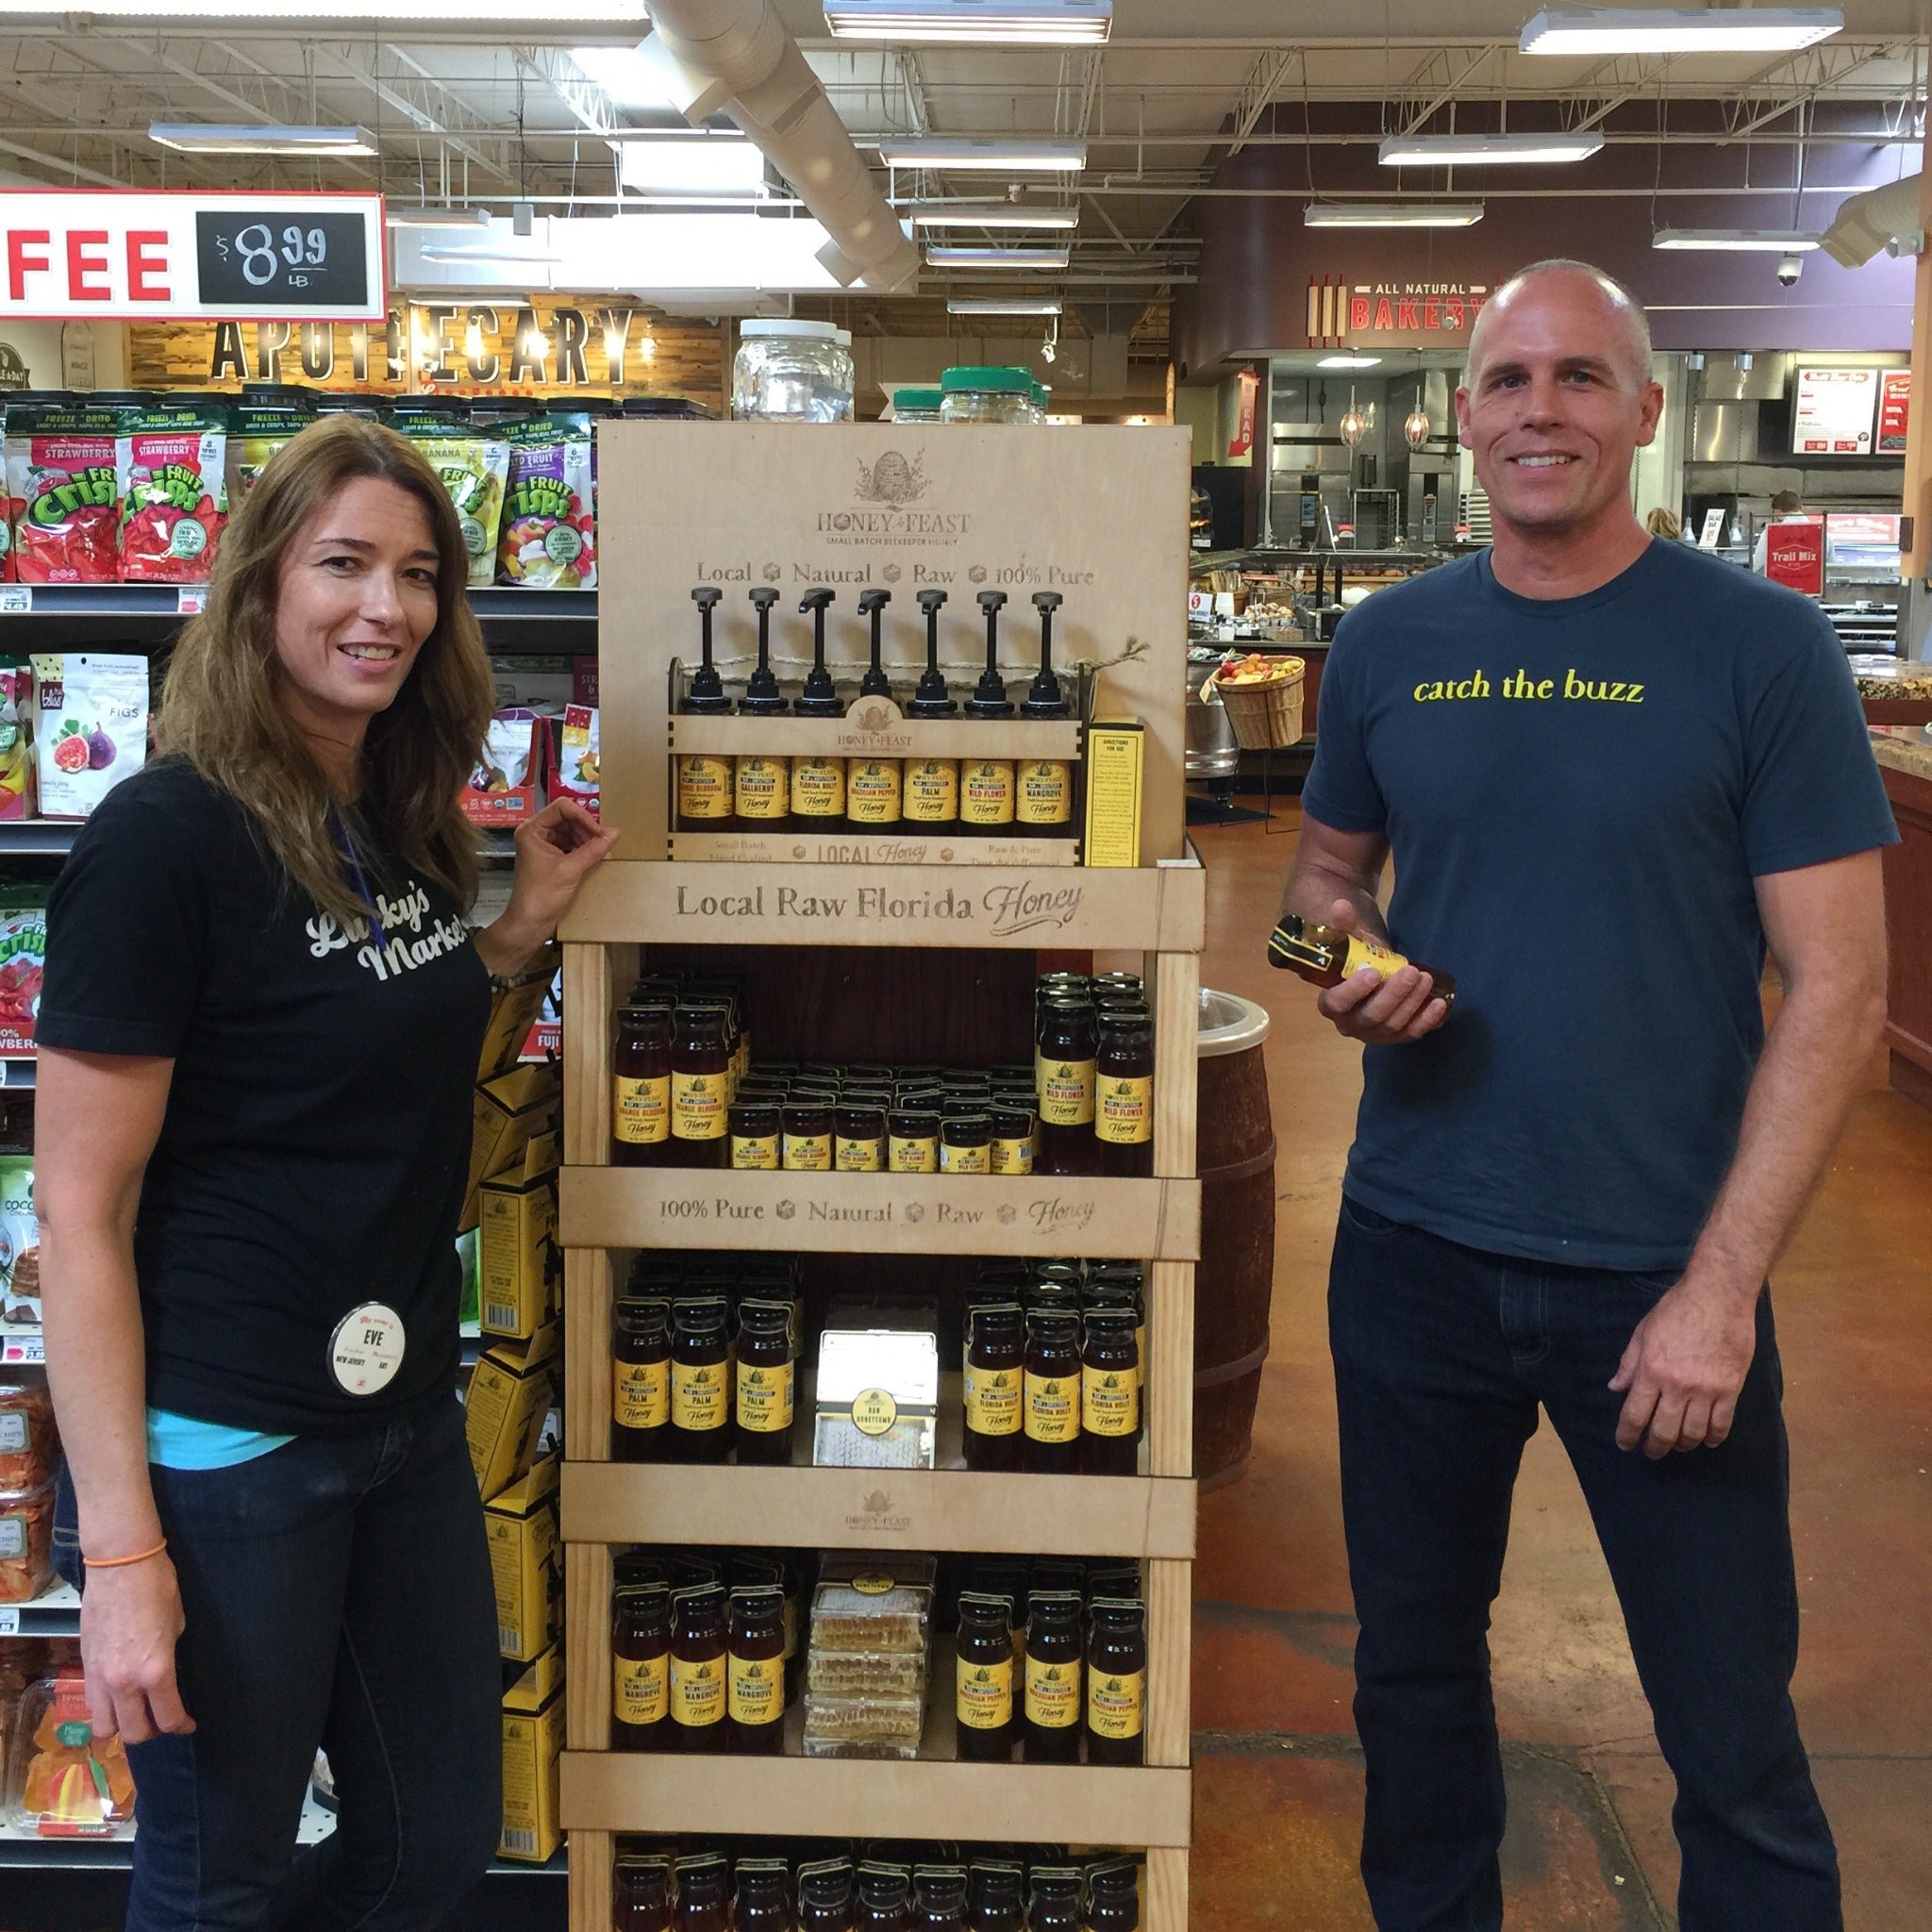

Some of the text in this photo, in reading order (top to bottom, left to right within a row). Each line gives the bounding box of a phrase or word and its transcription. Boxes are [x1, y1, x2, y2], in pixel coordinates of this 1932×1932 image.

[7, 229, 172, 302] FEE
[1375, 284, 1466, 295] ALL NATURAL
[528, 422, 553, 432] DRIED
[45, 447, 116, 458] STRAWBERRY
[139, 445, 190, 457] STRAWBERRY
[527, 453, 555, 469] FRUIT
[166, 465, 205, 490] FRUIT
[529, 475, 574, 497] FRUIT
[817, 512, 971, 534] HONEY FEAST
[826, 537, 852, 545] SMALL
[884, 538, 926, 546] BEEKEEPER
[1772, 551, 1817, 561] Trail Mix
[696, 561, 1095, 586] Local Natural Raw 100% Pure
[1413, 669, 1644, 704] catch the buzz
[110, 708, 140, 718] FIGS
[741, 783, 774, 792] GALLBERRY
[922, 788, 941, 796] PALM
[1026, 789, 1061, 797] MANGROVE
[686, 798, 711, 809] Honey
[743, 798, 771, 809] Honey
[804, 795, 832, 807] Honey
[916, 802, 943, 812] Honey
[858, 802, 887, 813] Honey
[973, 803, 1001, 815] Honey
[1030, 803, 1058, 815] Honey
[817, 845, 870, 863] LOCAL
[877, 841, 928, 862] Honey
[676, 880, 1085, 924] Local Raw Florida Honey
[305, 878, 430, 958] Luky's
[538, 1034, 559, 1050] FUJI
[1046, 1089, 1084, 1099] WILD FLOWER
[1050, 1104, 1078, 1116] Honey
[1104, 1107, 1142, 1116] WILD FLOWER
[627, 1123, 657, 1135] Honey
[684, 1119, 712, 1130] Honey
[1108, 1123, 1138, 1134] Honey
[659, 1197, 1095, 1229] 100% Pure Natural Raw Honey
[363, 1328, 385, 1347] EVE
[336, 1355, 366, 1367] NEW JERSEY
[628, 1393, 648, 1404] PALM
[691, 1396, 712, 1405] PALM
[746, 1396, 765, 1406] PALM
[625, 1407, 652, 1419] Honey
[687, 1409, 716, 1422] Honey
[742, 1409, 770, 1423] Honey
[985, 1414, 1013, 1426] Honey
[1096, 1415, 1124, 1426] Honey
[1037, 1422, 1065, 1433] Honey
[625, 1688, 660, 1699] MANGROVE
[737, 1688, 772, 1699] MANGROVE
[628, 1703, 657, 1715] Honey
[689, 1705, 716, 1717] Honey
[741, 1705, 768, 1716] Honey
[968, 1708, 996, 1719] Honey
[1038, 1707, 1065, 1719] Honey
[1099, 1717, 1127, 1730] Honey
